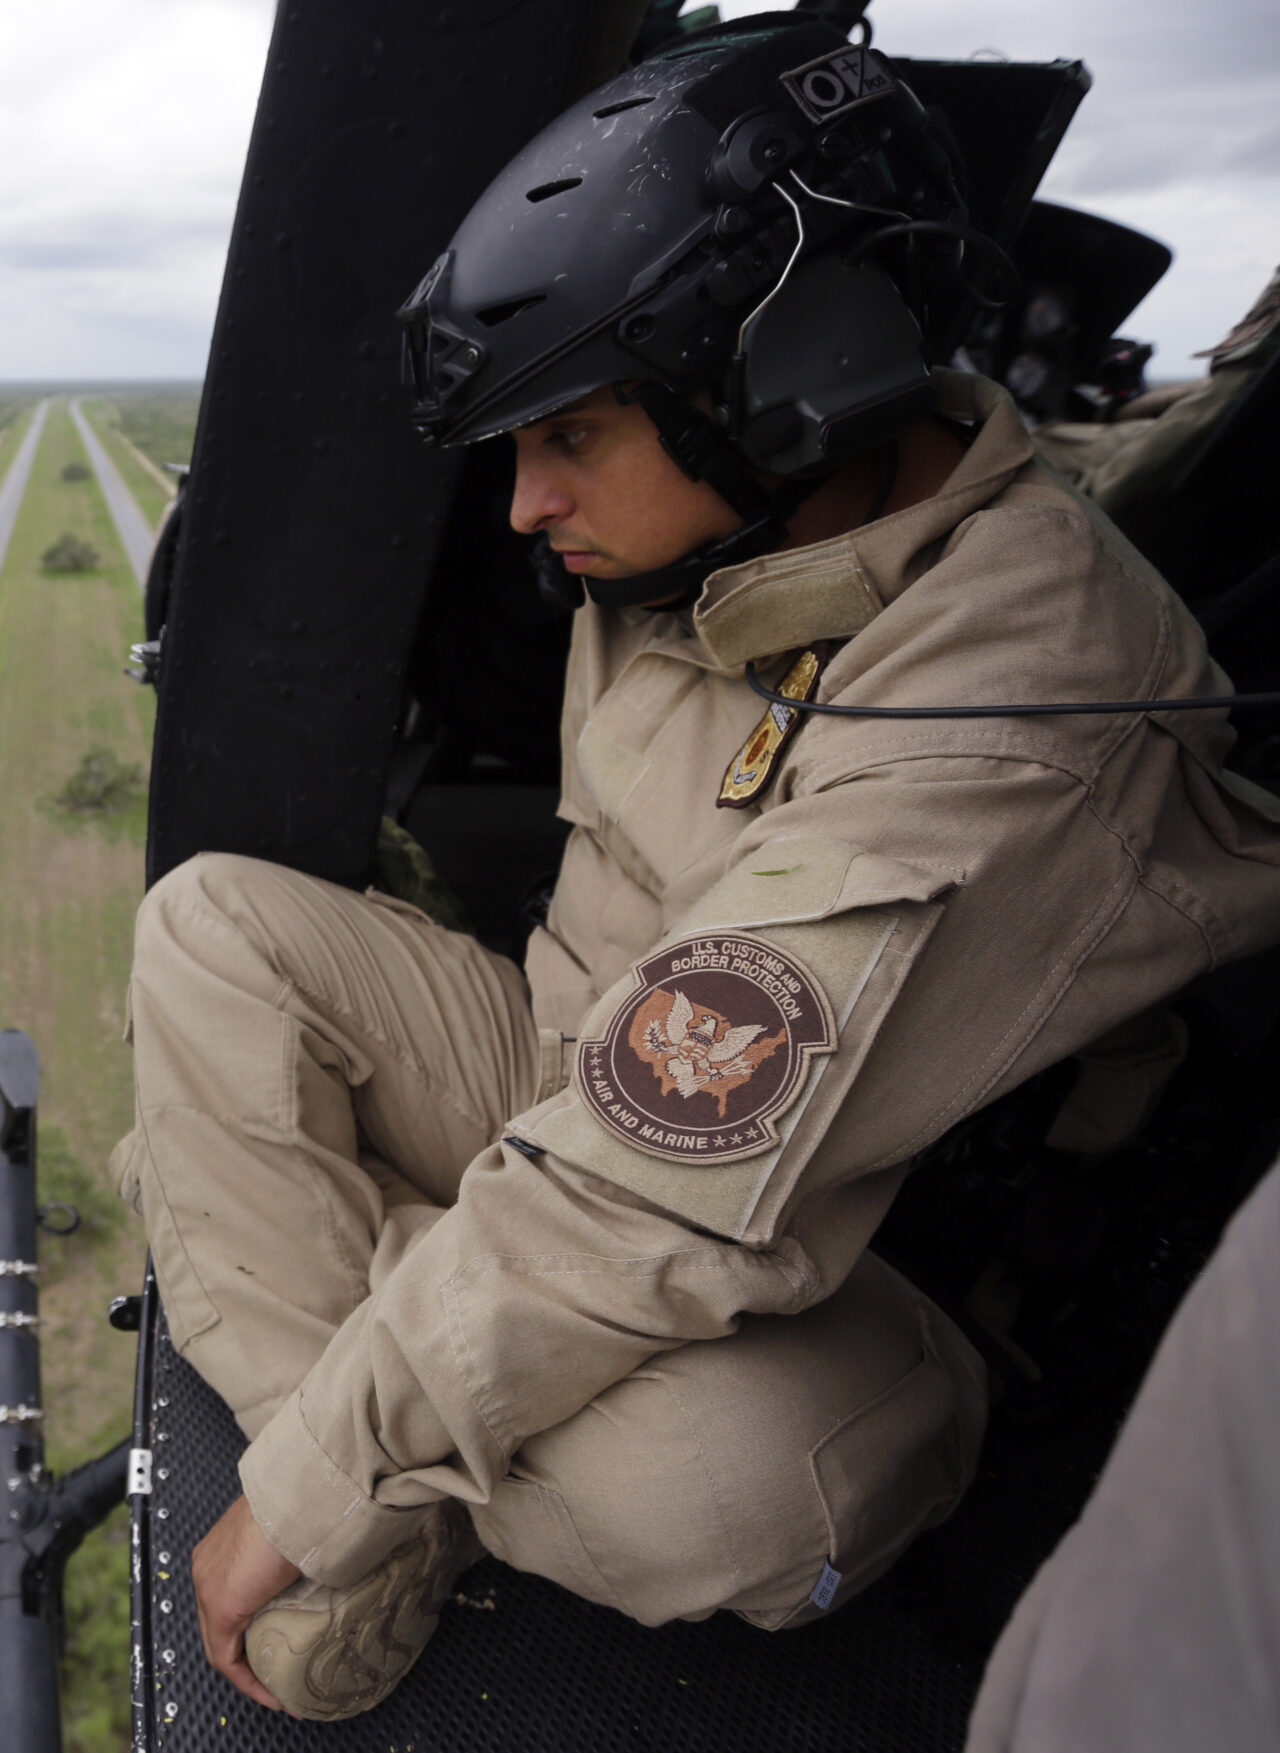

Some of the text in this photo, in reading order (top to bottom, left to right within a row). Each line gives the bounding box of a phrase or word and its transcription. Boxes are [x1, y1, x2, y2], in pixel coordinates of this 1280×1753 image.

[802, 70, 845, 107] O
[671, 954, 803, 1021] BORDER PROTECTION
[691, 941, 801, 994] U.S. CUSTOMS AND
[592, 1080, 709, 1150] AIR AND MARINE
